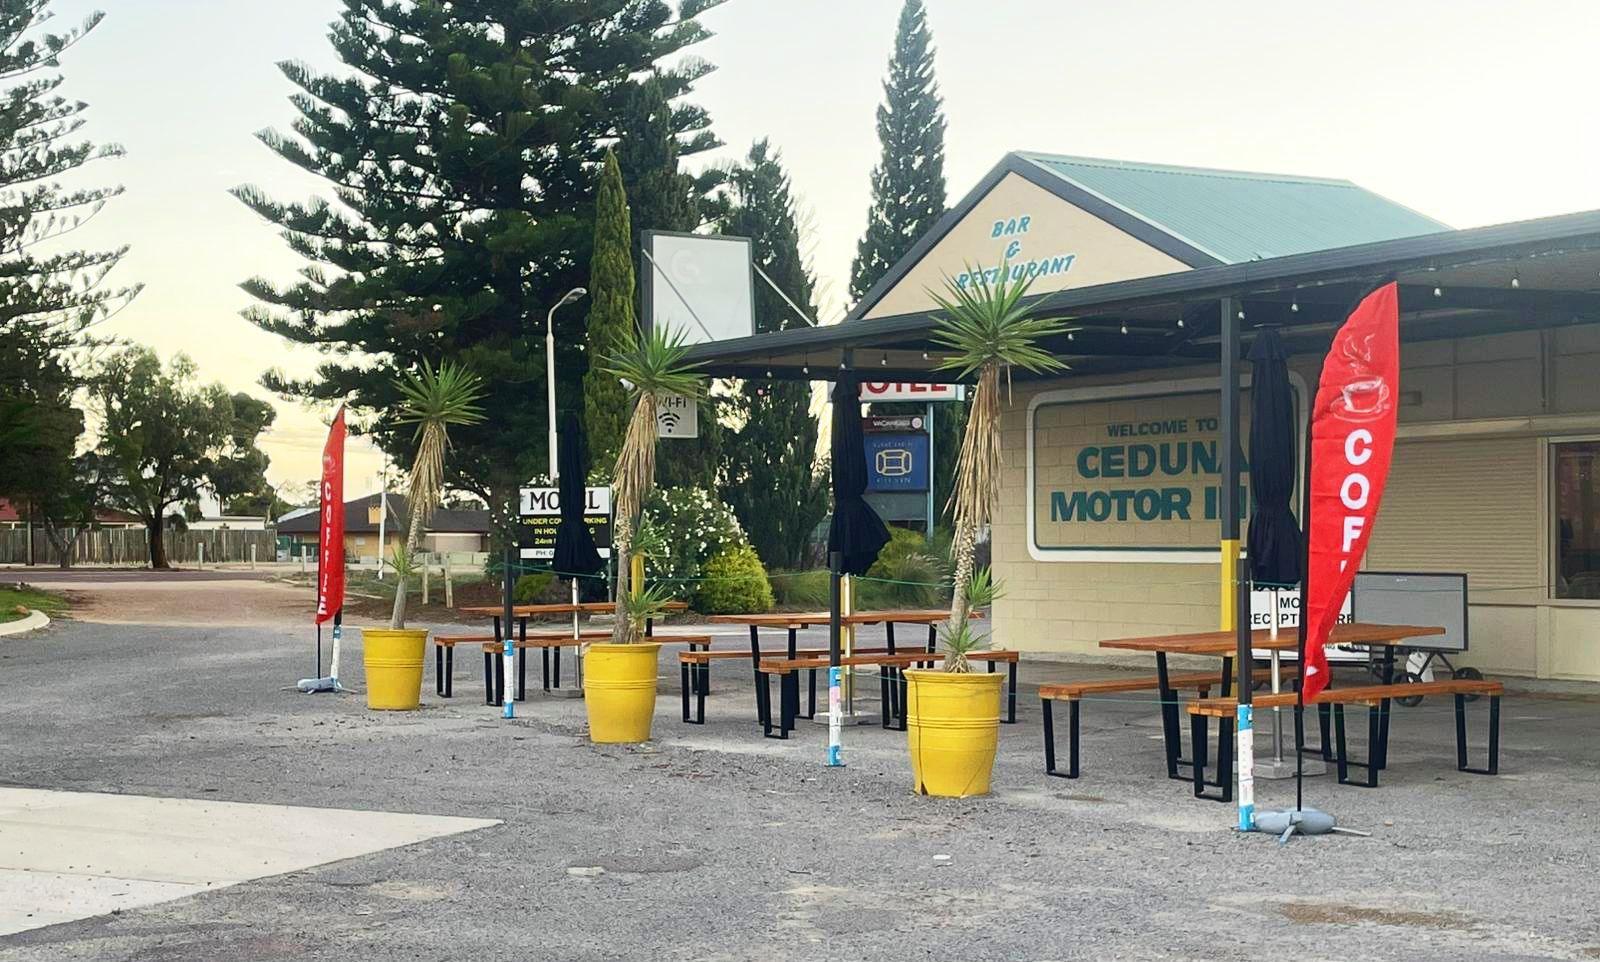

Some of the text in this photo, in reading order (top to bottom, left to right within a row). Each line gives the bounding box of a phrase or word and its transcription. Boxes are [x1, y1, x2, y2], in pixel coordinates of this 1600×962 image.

[991, 215, 1031, 238] BAR
[1006, 241, 1020, 258] &
[1107, 418, 1218, 437] WELCOME TO
[1050, 488, 1192, 522] MOTOR
[522, 517, 548, 525] UNDER
[534, 527, 543, 535] IN
